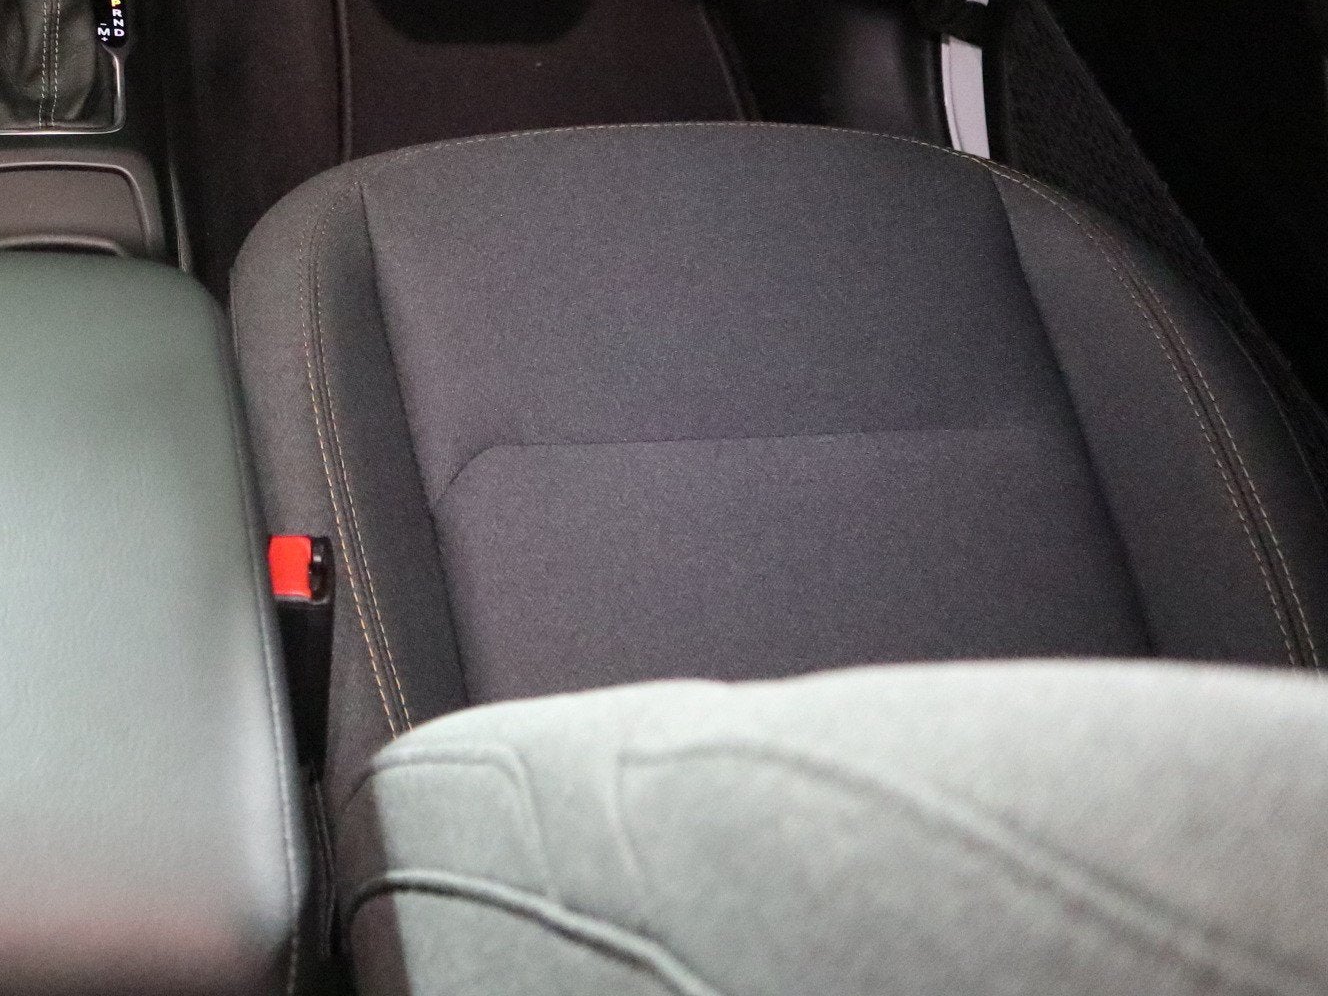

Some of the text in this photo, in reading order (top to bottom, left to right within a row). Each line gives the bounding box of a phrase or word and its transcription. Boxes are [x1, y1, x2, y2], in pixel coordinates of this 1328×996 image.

[112, 8, 122, 17] R
[113, 18, 124, 27] N
[97, 27, 110, 36] M
[114, 28, 125, 36] D
